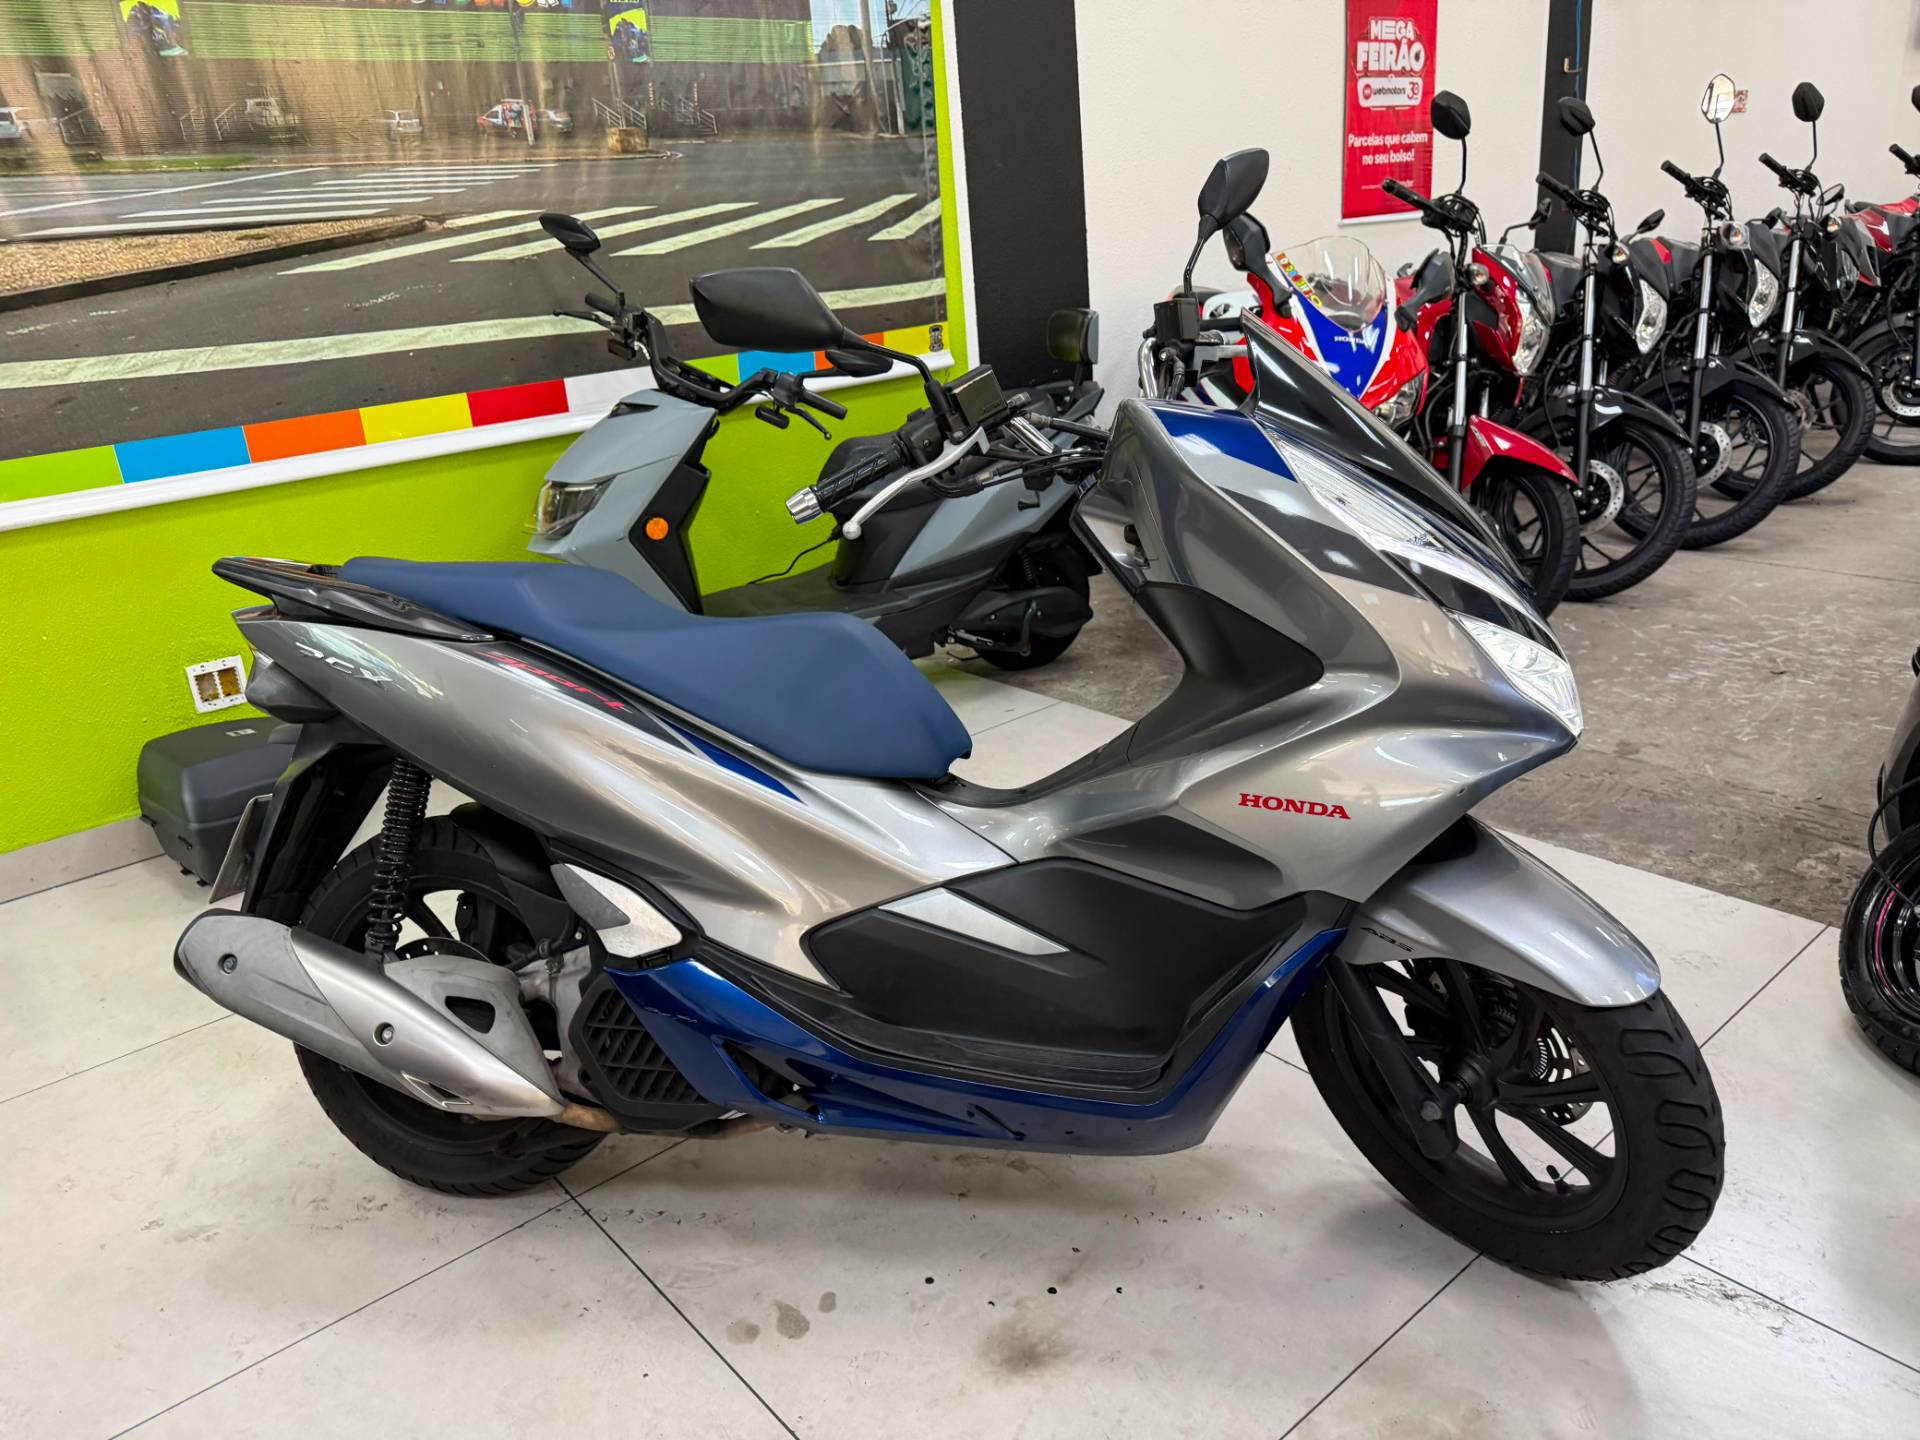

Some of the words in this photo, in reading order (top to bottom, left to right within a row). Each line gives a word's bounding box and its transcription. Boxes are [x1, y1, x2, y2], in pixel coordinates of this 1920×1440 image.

[1370, 19, 1414, 40] MEGA
[1356, 39, 1425, 72] FEIRÃO
[1348, 132, 1384, 147] Parcelas
[1385, 133, 1400, 147] que
[1401, 130, 1428, 144] cabem
[1362, 154, 1373, 165] no
[1375, 153, 1389, 164] seu
[1390, 149, 1415, 163] bolso!
[1238, 793, 1351, 820] HONDA
